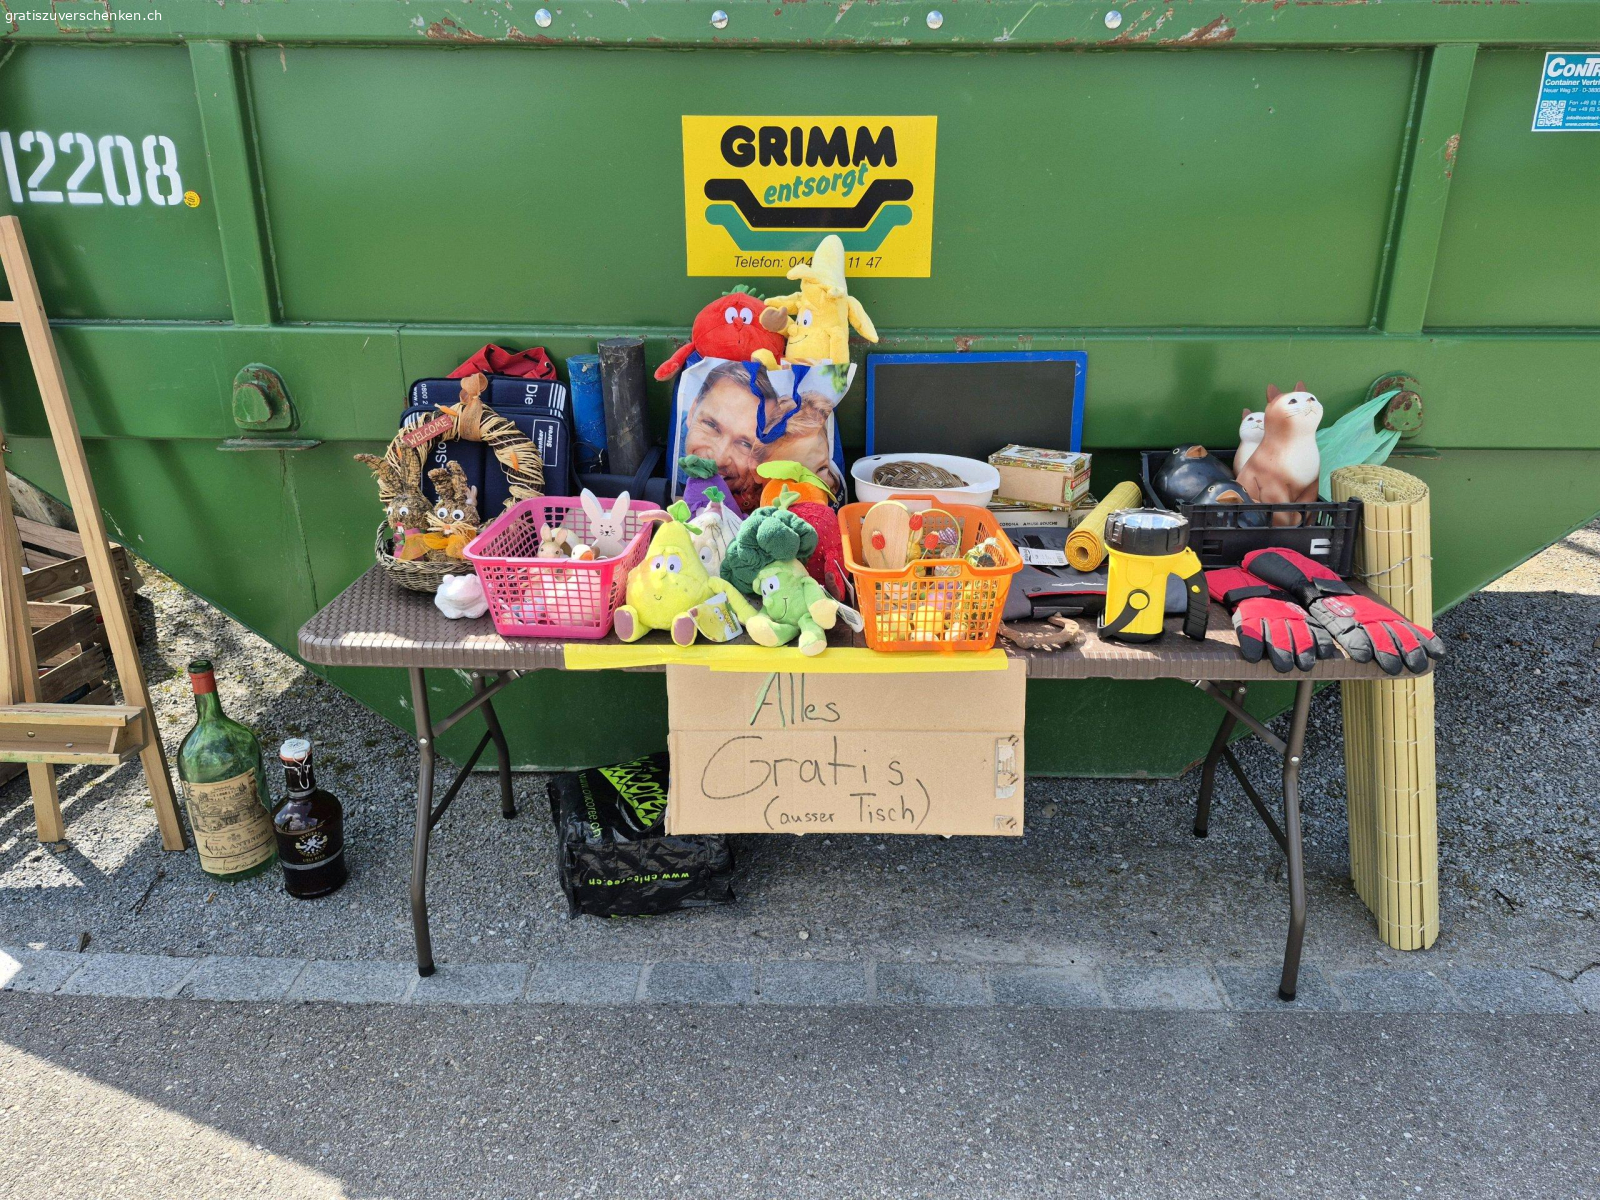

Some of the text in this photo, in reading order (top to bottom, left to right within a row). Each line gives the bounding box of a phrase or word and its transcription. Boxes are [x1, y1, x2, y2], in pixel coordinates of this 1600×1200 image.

[0, 130, 184, 206] 12208
[720, 124, 898, 168] GRIMM
[763, 162, 869, 206] entsorgt
[733, 255, 784, 268] Telefon:
[866, 256, 882, 268] 47
[524, 383, 539, 405] Die
[406, 417, 449, 447] WELCOME
[750, 671, 841, 729] Alles
[763, 778, 930, 831] (ausser Tisch)
